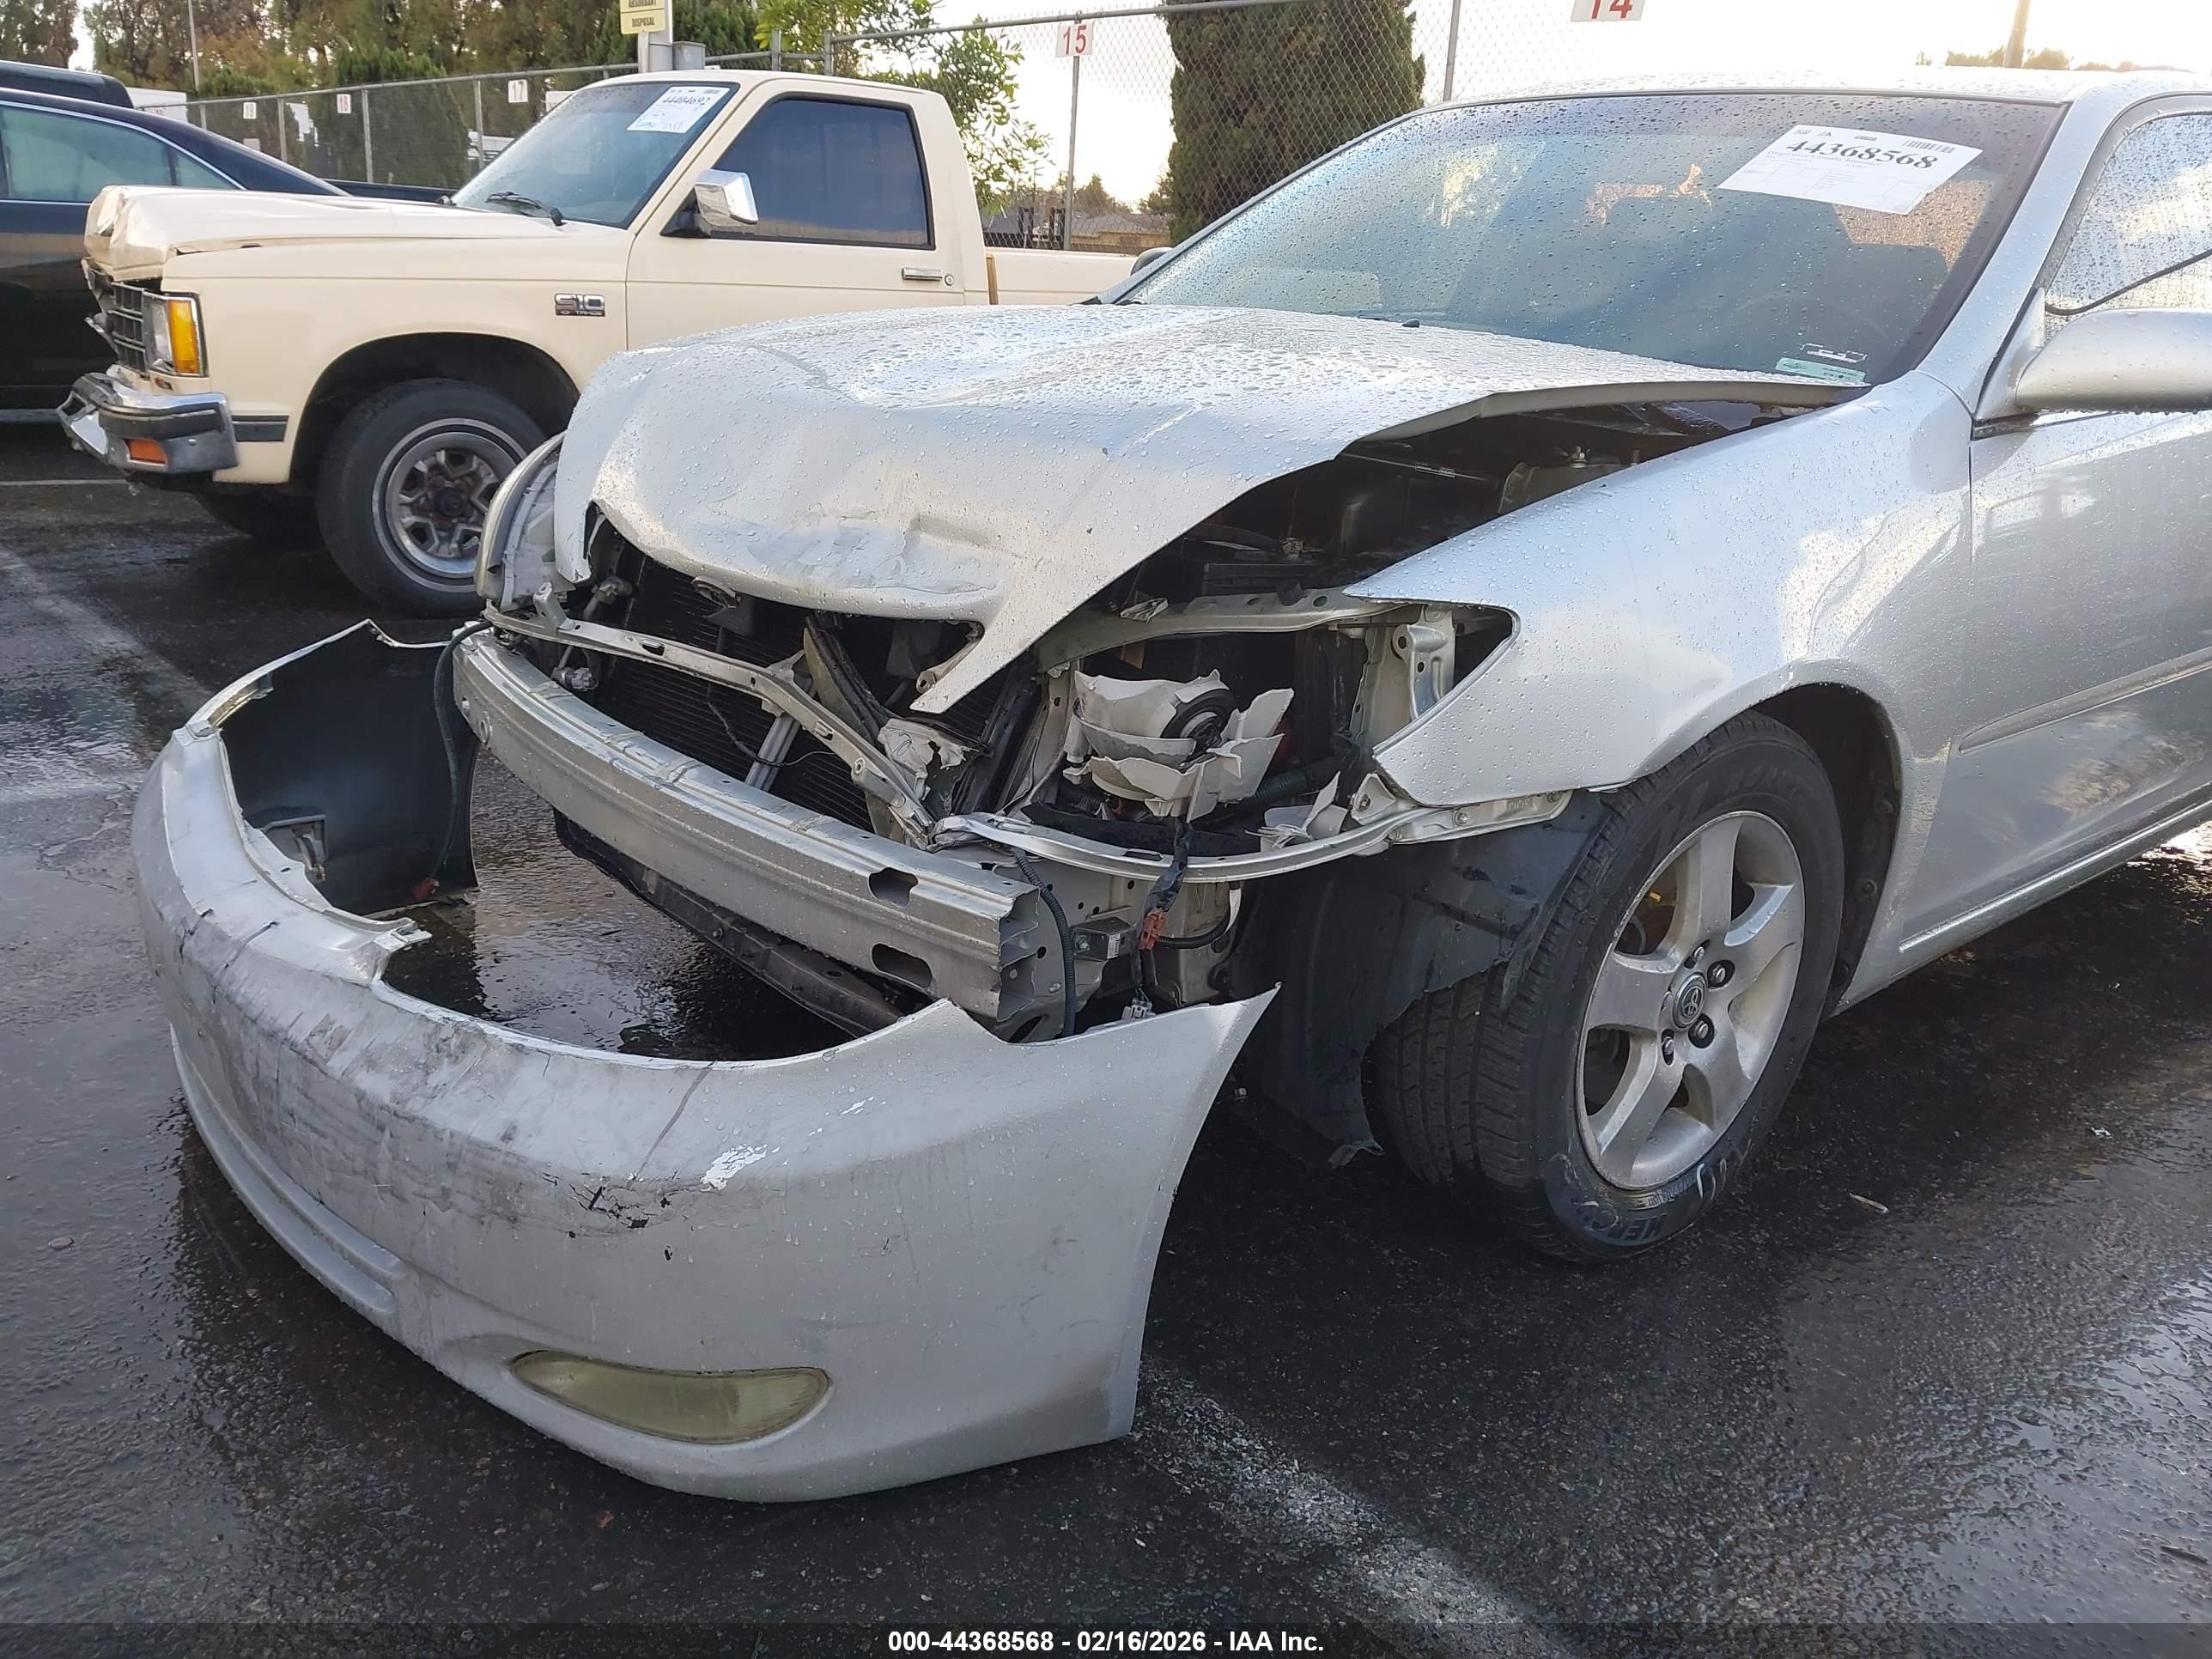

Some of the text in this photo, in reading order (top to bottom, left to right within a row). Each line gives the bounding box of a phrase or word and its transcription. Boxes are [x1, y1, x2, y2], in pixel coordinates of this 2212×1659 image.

[631, 17, 655, 27] DISPOSAL
[1063, 24, 1087, 55] 15
[512, 80, 524, 101] 17
[338, 95, 349, 112] 18
[1786, 140, 1938, 169] 44368568
[555, 293, 605, 310] S10
